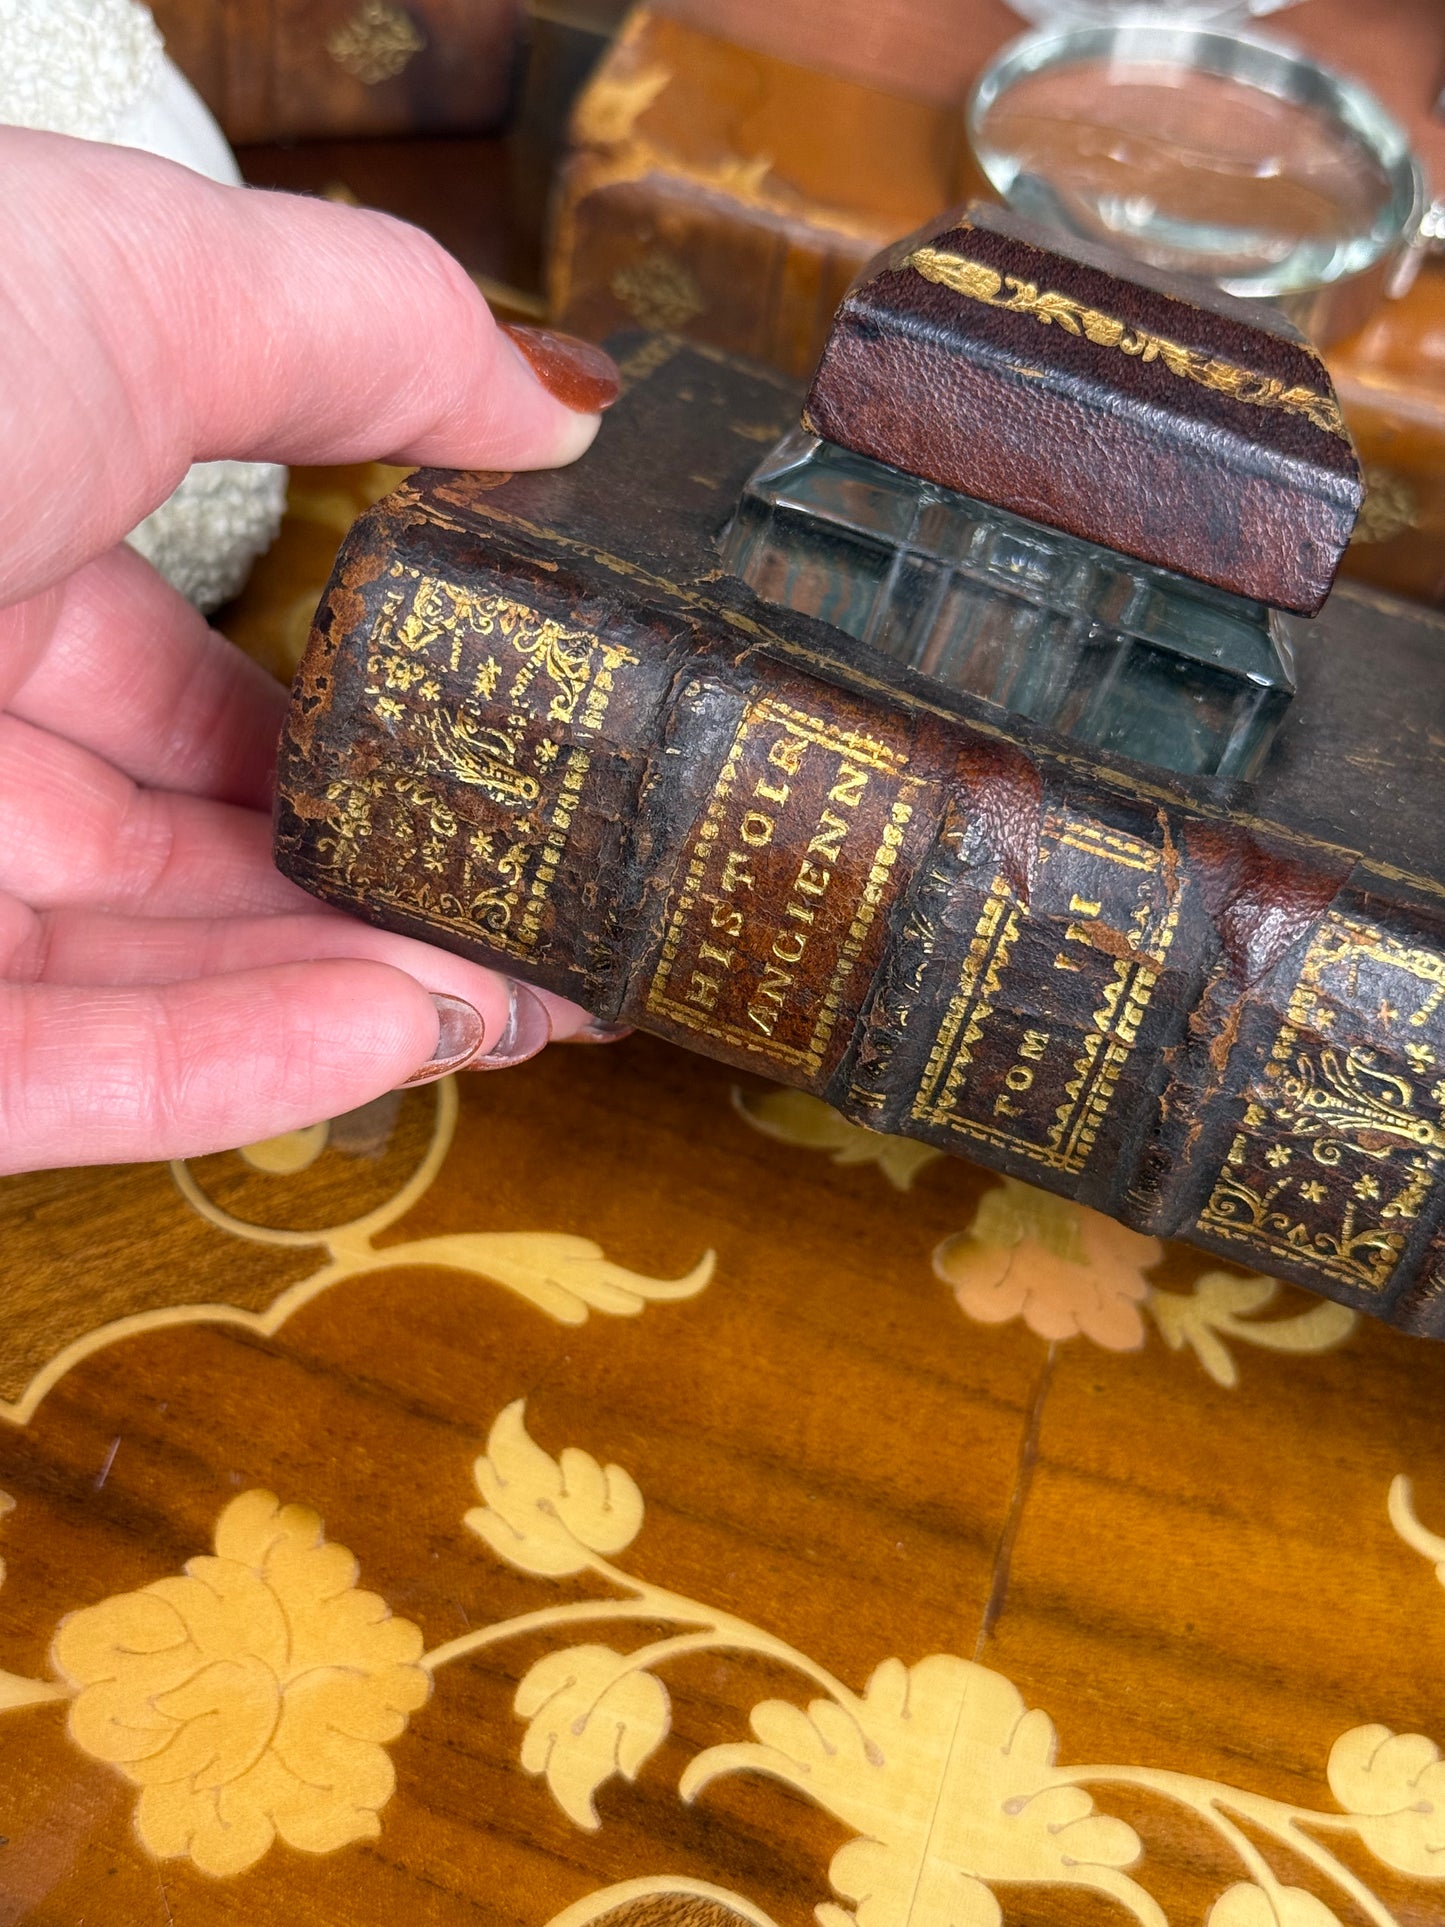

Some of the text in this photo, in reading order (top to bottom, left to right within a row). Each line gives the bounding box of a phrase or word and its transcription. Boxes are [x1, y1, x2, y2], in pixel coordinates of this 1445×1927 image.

[687, 737, 809, 1010] HISTOIR
[747, 762, 869, 1037] ANCIENN
[994, 1029, 1050, 1117] TOM
